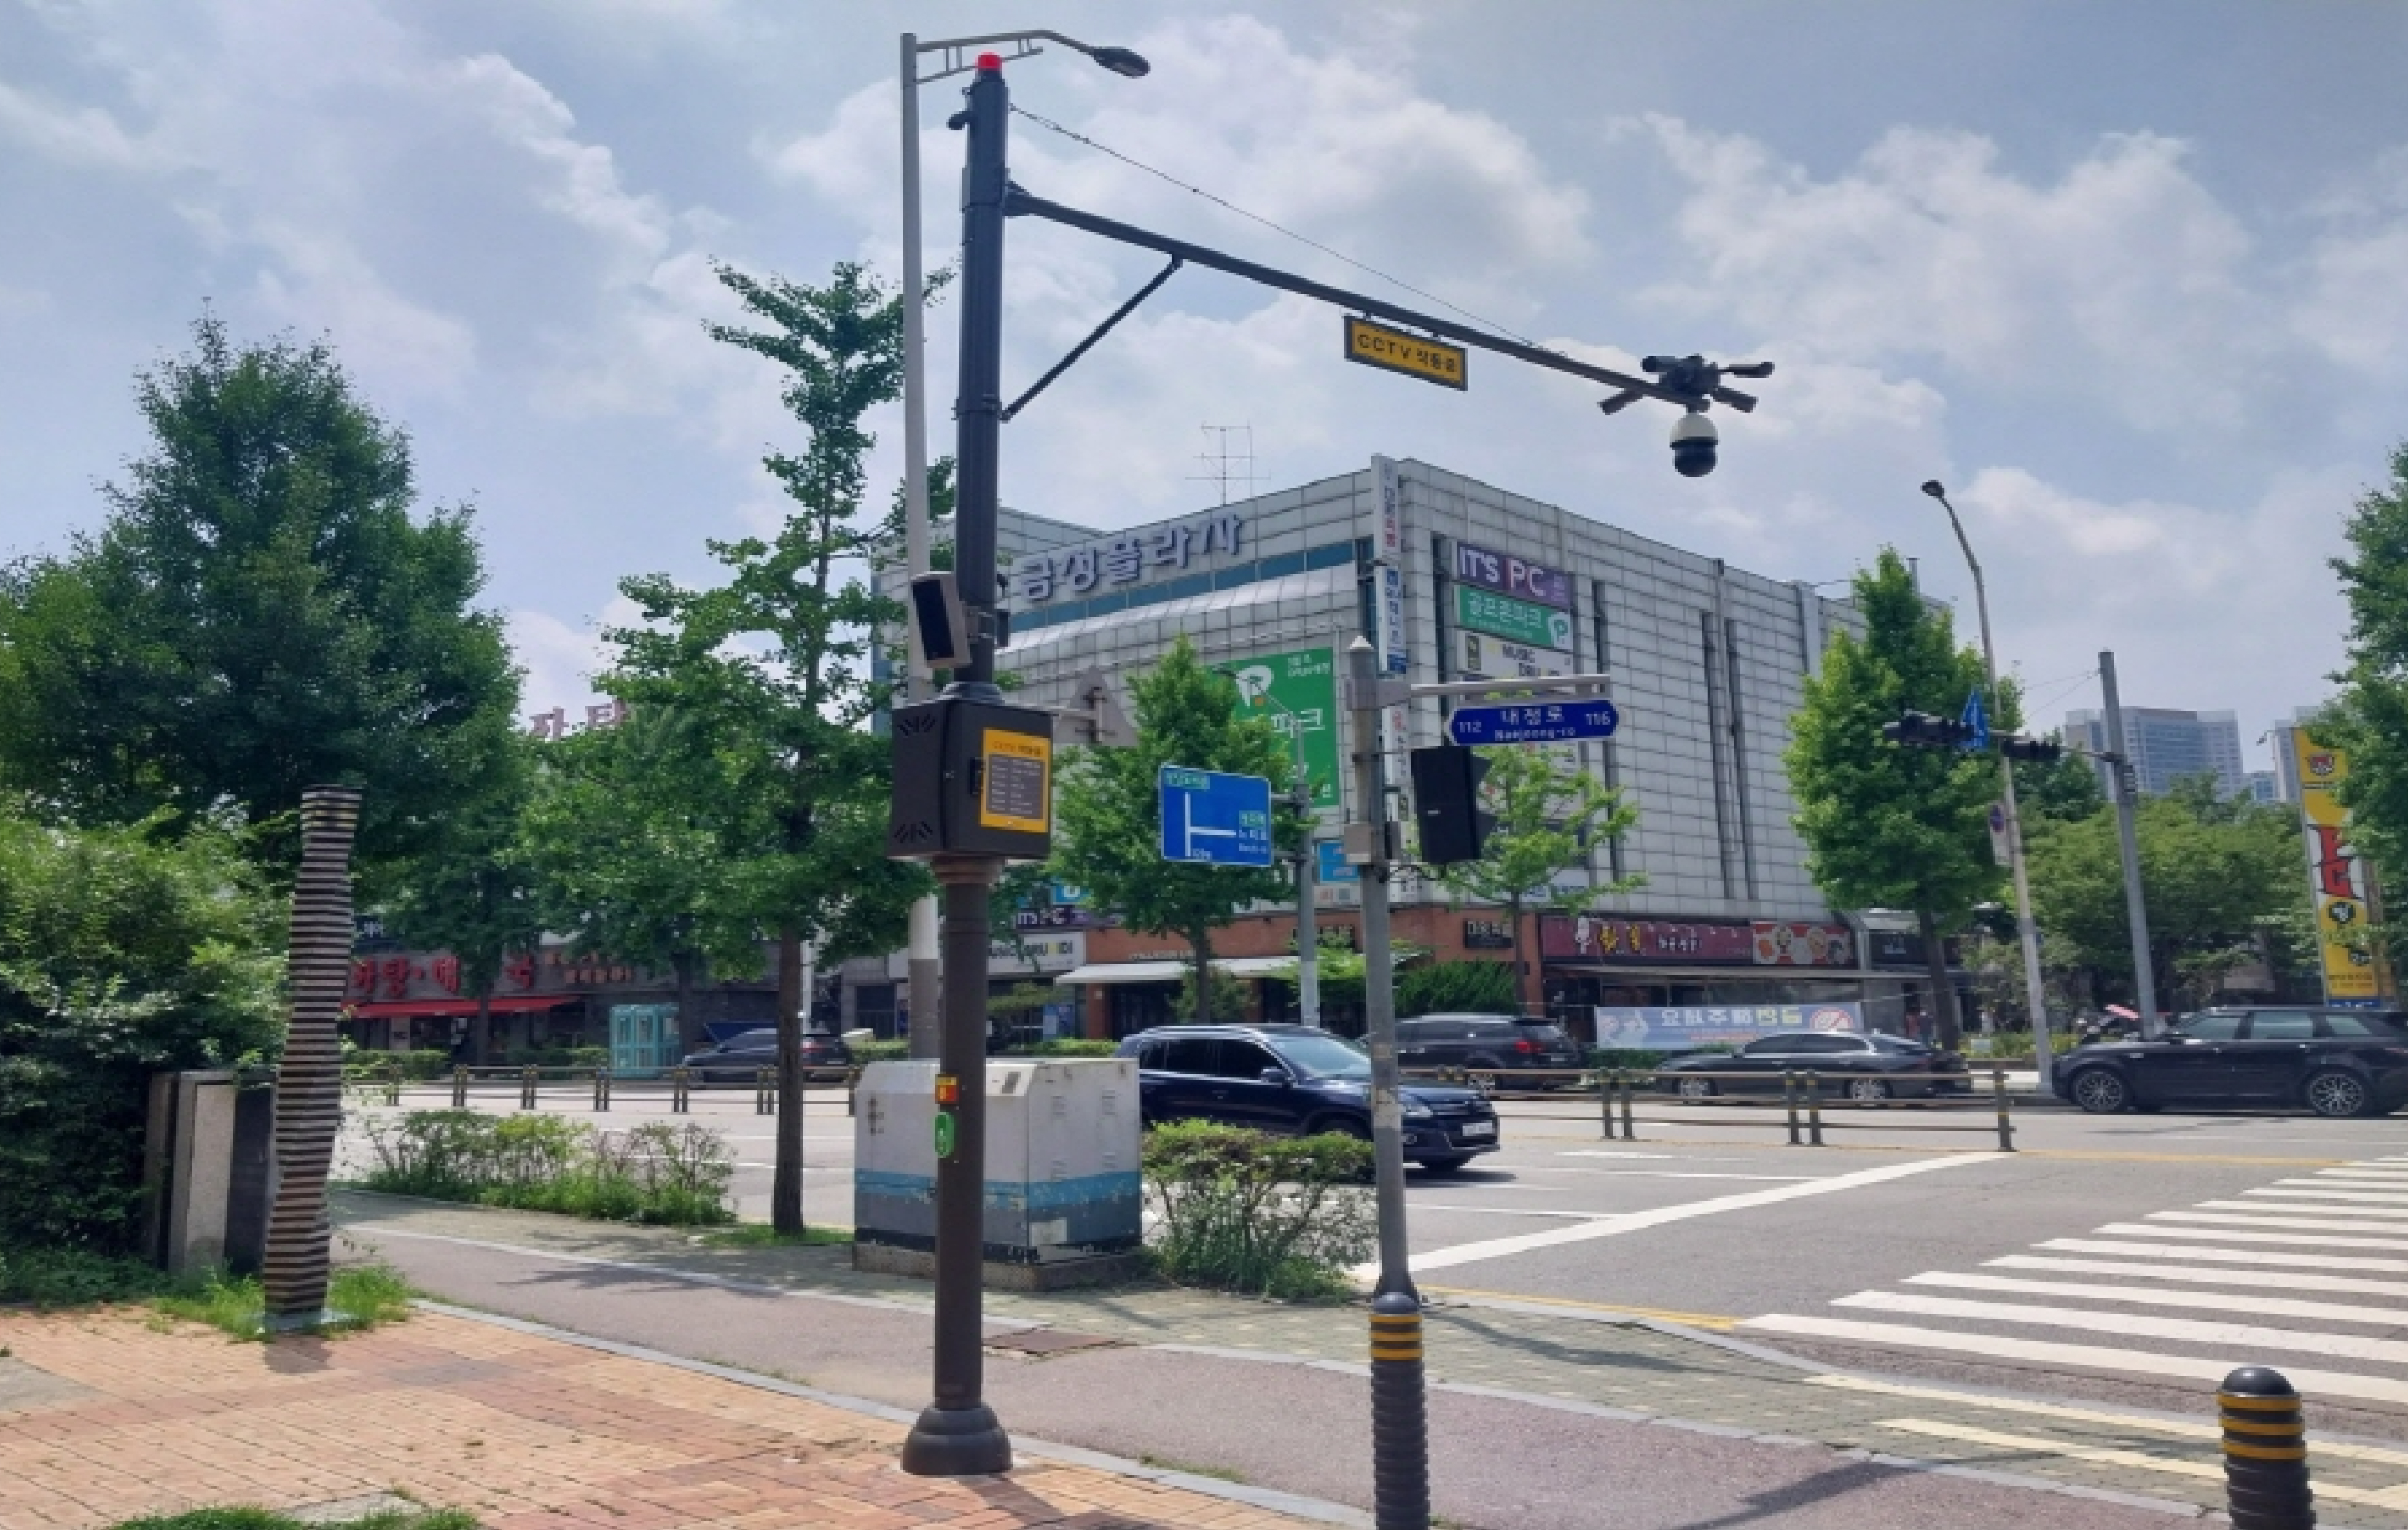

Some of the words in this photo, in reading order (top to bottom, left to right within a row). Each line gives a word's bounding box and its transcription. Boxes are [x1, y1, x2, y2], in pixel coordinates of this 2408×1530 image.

[1357, 333, 1411, 359] CCTV
[1020, 513, 1243, 601] 금성플라자
[1507, 560, 1546, 597] PC
[1458, 720, 1483, 734] 112
[1500, 705, 1565, 727] 내정로
[1584, 711, 1612, 727] 116
